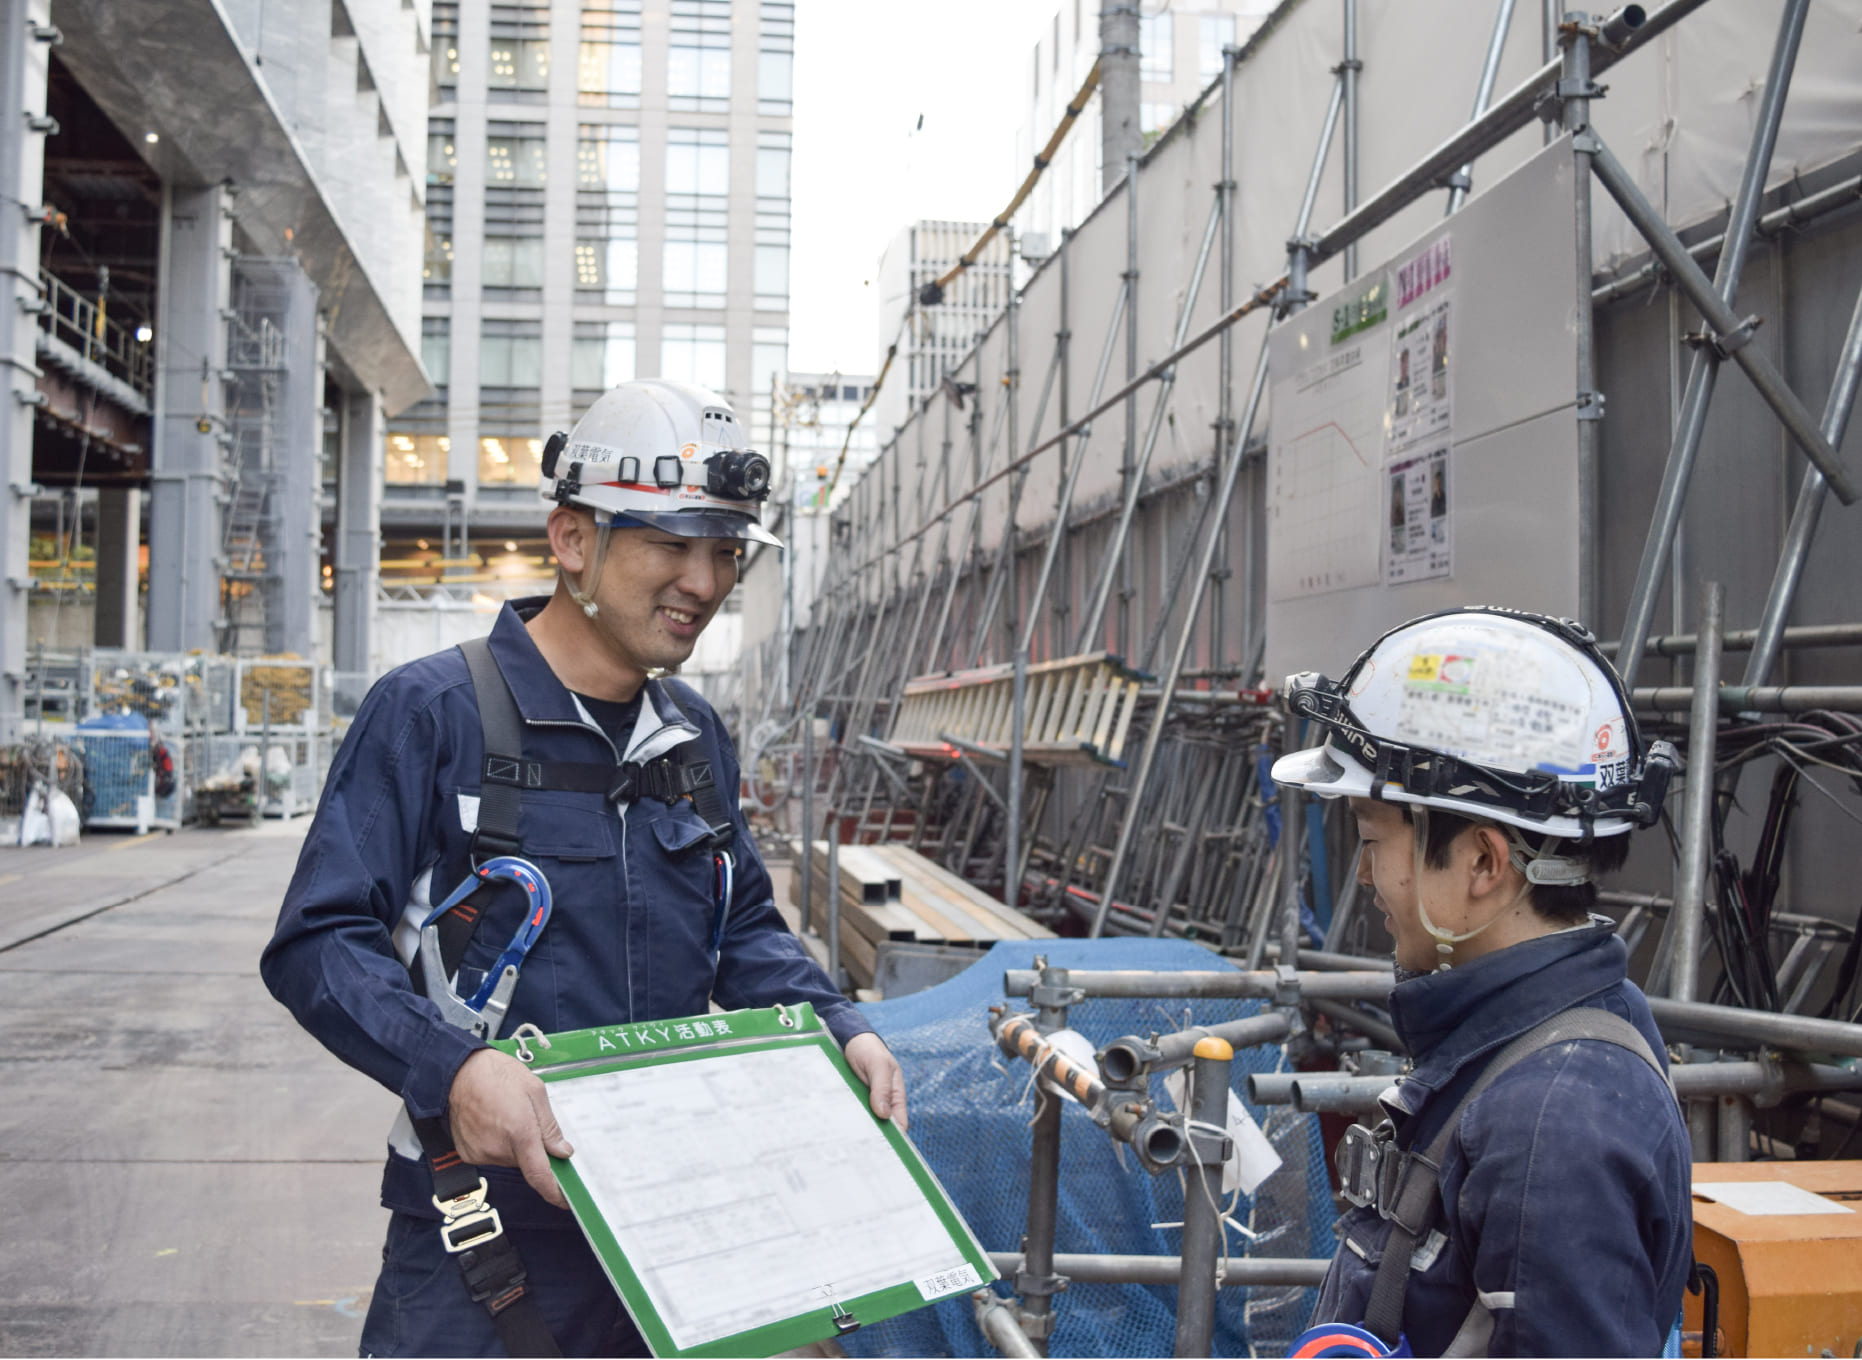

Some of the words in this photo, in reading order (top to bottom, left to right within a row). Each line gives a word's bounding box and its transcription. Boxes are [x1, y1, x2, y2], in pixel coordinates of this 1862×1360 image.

[1600, 760, 1630, 789] 双葉
[923, 1269, 975, 1295] 双葉電気
